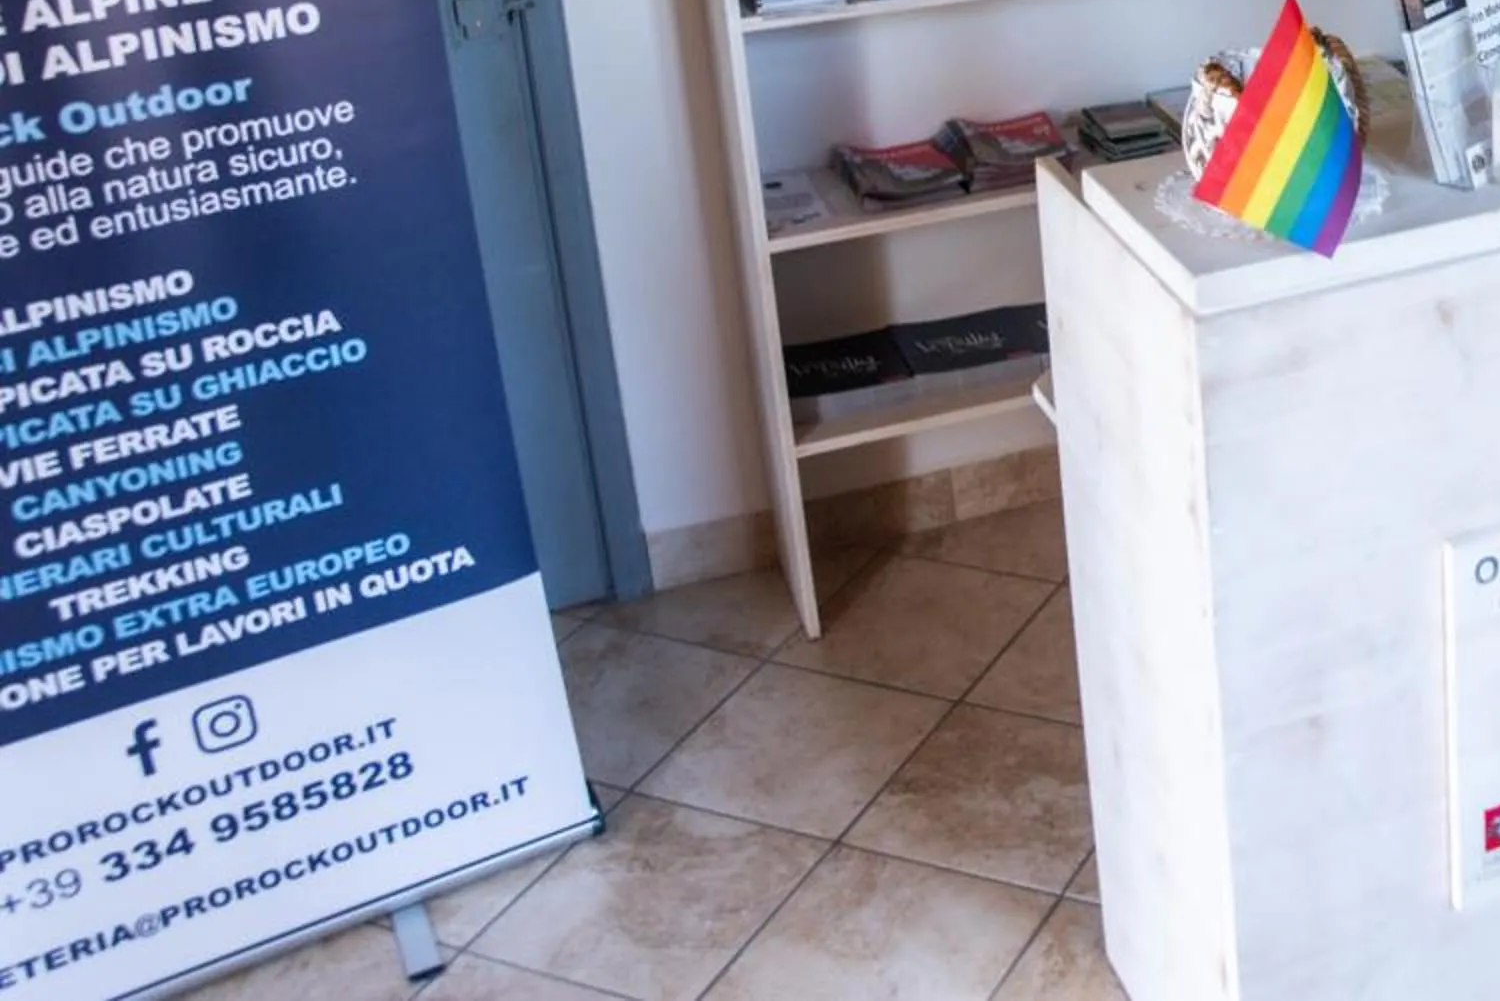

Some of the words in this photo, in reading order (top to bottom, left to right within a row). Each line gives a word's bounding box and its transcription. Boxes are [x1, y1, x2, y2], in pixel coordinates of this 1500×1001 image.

[42, 1, 321, 81] ALPINISMO
[59, 77, 253, 135] Outdoor
[104, 136, 171, 171] che
[181, 100, 356, 160] promuove
[25, 183, 94, 221] alla
[104, 159, 219, 203] natura
[229, 136, 343, 177] sicuro,
[30, 216, 80, 252] ed
[90, 164, 358, 240] entusiasmante.
[0, 269, 194, 337] LPINISMO
[27, 296, 239, 369] ALPINISMO
[141, 343, 194, 378] SU
[202, 309, 343, 363] ROCCIA
[0, 399, 123, 452] ICATA
[130, 383, 182, 418] SU
[192, 337, 368, 401] GHIACCIO
[0, 450, 63, 489] VIE
[68, 404, 242, 471] FERRATE
[11, 440, 245, 522] CANYONING
[13, 472, 254, 559] CIASPOLATE
[140, 482, 343, 560] CULTURALI
[0, 623, 105, 677] ISMO
[113, 588, 240, 642] EXTRA
[246, 532, 412, 601] EUROPEO
[48, 545, 251, 622] TREKKING
[0, 664, 86, 712] ONE
[92, 640, 170, 684] PER
[177, 596, 308, 657] LAVORI
[314, 582, 353, 614] IN
[359, 545, 477, 599] QUOTA
[0, 716, 399, 874] PROROCKOUTDOOR.IT
[0, 867, 82, 915] +39
[98, 827, 197, 884] 334
[209, 750, 416, 846] 9585828
